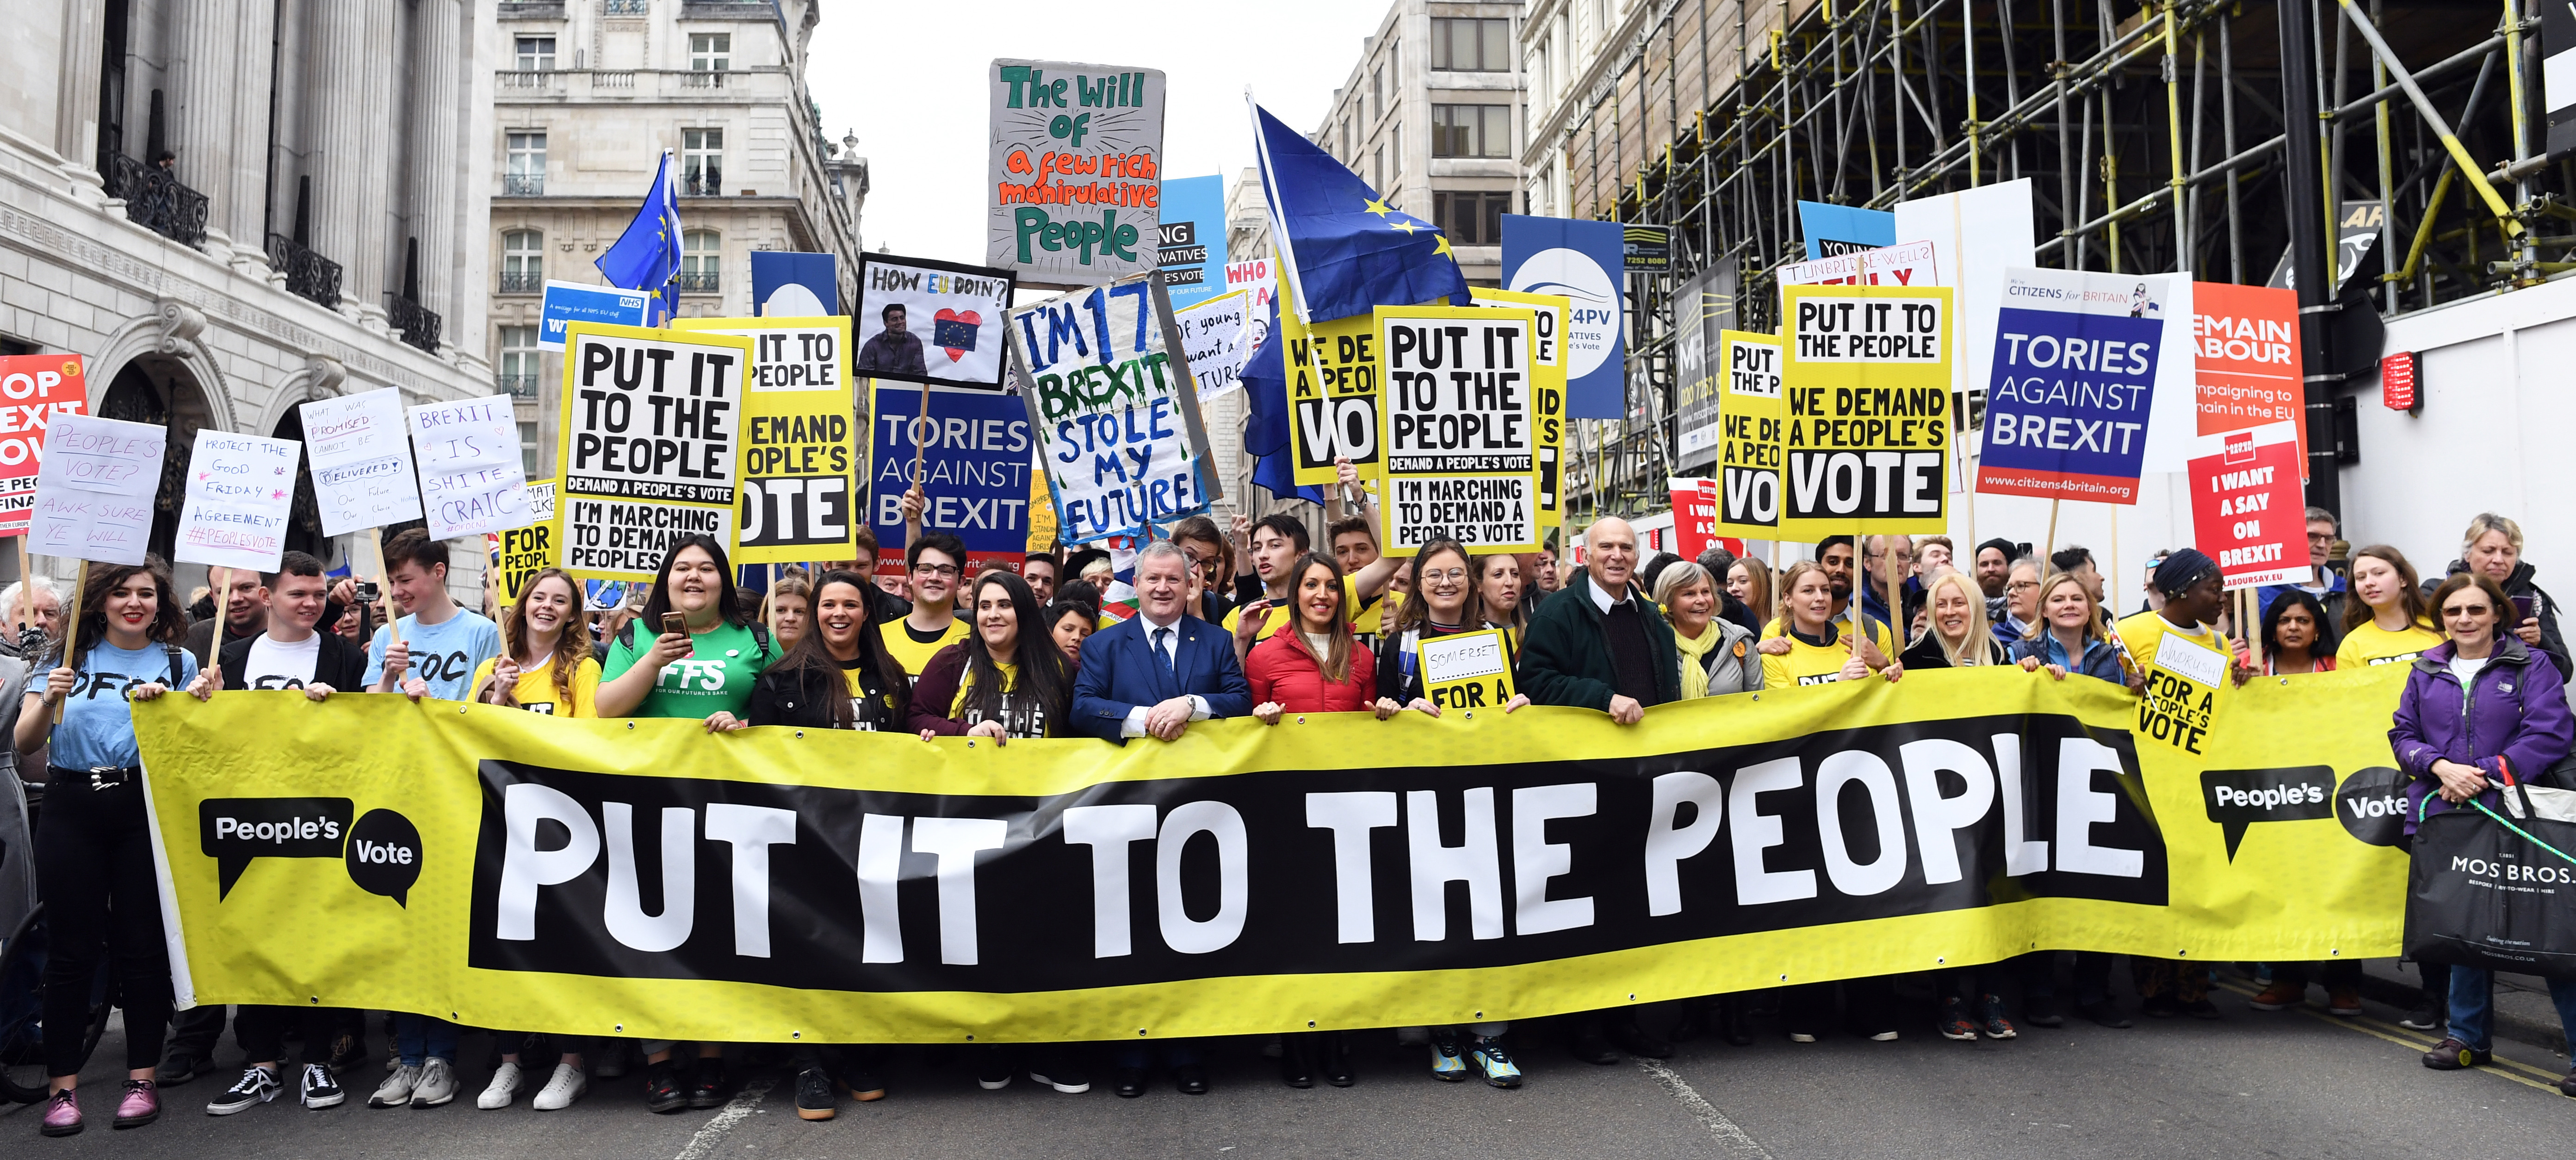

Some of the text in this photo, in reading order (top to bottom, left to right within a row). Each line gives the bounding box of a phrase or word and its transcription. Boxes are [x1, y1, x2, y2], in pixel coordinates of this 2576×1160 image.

[1000, 66, 1067, 109] The
[1049, 112, 1090, 147] of
[1007, 150, 1158, 188] a few rich
[998, 181, 1158, 208] manipulative
[1015, 207, 1139, 265] People
[1180, 270, 1205, 281] VOTE
[1226, 261, 1266, 284] WHO
[872, 266, 1008, 308] HOW EU DOIN'?
[2009, 286, 2128, 303] CITIZENS for BRITAIN
[555, 305, 572, 314] message
[620, 298, 640, 307] NHS
[1015, 280, 1148, 373] I'M 17
[1201, 312, 1240, 335] young
[1799, 302, 1936, 333] PUT IT TO
[1186, 339, 1233, 363] want a
[1391, 325, 1519, 370] PUT IT
[1798, 334, 1935, 358] THE PEOPLE
[2004, 333, 2150, 376] TORIES
[582, 342, 734, 397] PUT IT
[1037, 352, 1176, 424] BREXIT
[1392, 371, 1522, 411] TO THE
[1681, 376, 1713, 407] 020 7252
[1996, 376, 2146, 411] AGAINST
[2277, 389, 2292, 401] to
[307, 401, 366, 419] WHAT WAS
[1790, 387, 1944, 416] WE DEMAND
[2230, 402, 2294, 420] in the EU
[311, 416, 369, 439] PROMISED
[420, 404, 492, 429] BREXIT
[581, 389, 730, 442] TO THE
[55, 424, 160, 457] PEOPLE'S
[1057, 397, 1174, 463] STOLE
[1393, 413, 1523, 450] PEOPLE
[1789, 419, 1944, 447] A PEOPLE'S
[1992, 413, 2141, 455] BREXIT
[206, 440, 287, 457] PROTECT THE
[315, 434, 374, 454] CANNOT BE
[446, 436, 481, 458] IS
[576, 432, 727, 480] PEOPLE
[66, 458, 139, 484] VOTE?
[212, 459, 249, 474] GOOD
[1094, 444, 1152, 487] MY
[1390, 456, 1530, 470] DEMAND A PEOPLE'S VOTE
[206, 482, 263, 498] FRIDAY
[428, 468, 505, 492] SHITE
[567, 478, 732, 502] DEMAND A PEOPLE'S VOTE
[1398, 479, 1522, 501] I'M MARCHING
[1791, 451, 1940, 514] VOTE
[1985, 476, 2130, 498] www.citizens4britain.org
[2212, 465, 2274, 493] I WANT
[338, 487, 389, 505] Our Future
[442, 489, 513, 524] CRAIC
[2221, 492, 2269, 517] A SAY
[42, 498, 146, 521] AWK SURE
[194, 506, 282, 528] AGREEMENT
[343, 505, 390, 520] Our Choice
[574, 501, 719, 532] I'M MARCHING
[1398, 501, 1523, 524] TO DEMAND A
[46, 524, 127, 542] YE WILL
[446, 520, 488, 532] #OFOCNI
[574, 524, 602, 548] TO
[1483, 524, 1524, 542] VOTE
[2233, 519, 2260, 540] ON
[2219, 543, 2283, 568] BREXIT
[2223, 573, 2283, 587] LABOURSAY.EU
[1430, 644, 1497, 669] SOMERSET
[2148, 669, 2212, 715] FOR A
[2142, 695, 2209, 728] PEOPLE'S
[2140, 706, 2206, 755] VOTE
[2215, 782, 2408, 819] People's Vote
[216, 816, 413, 865] People's Vote
[496, 732, 2144, 966] PUT IT TO THE PEOPLE
[2468, 879, 2493, 888] BESPOKE
[2486, 935, 2504, 945] Suiting
